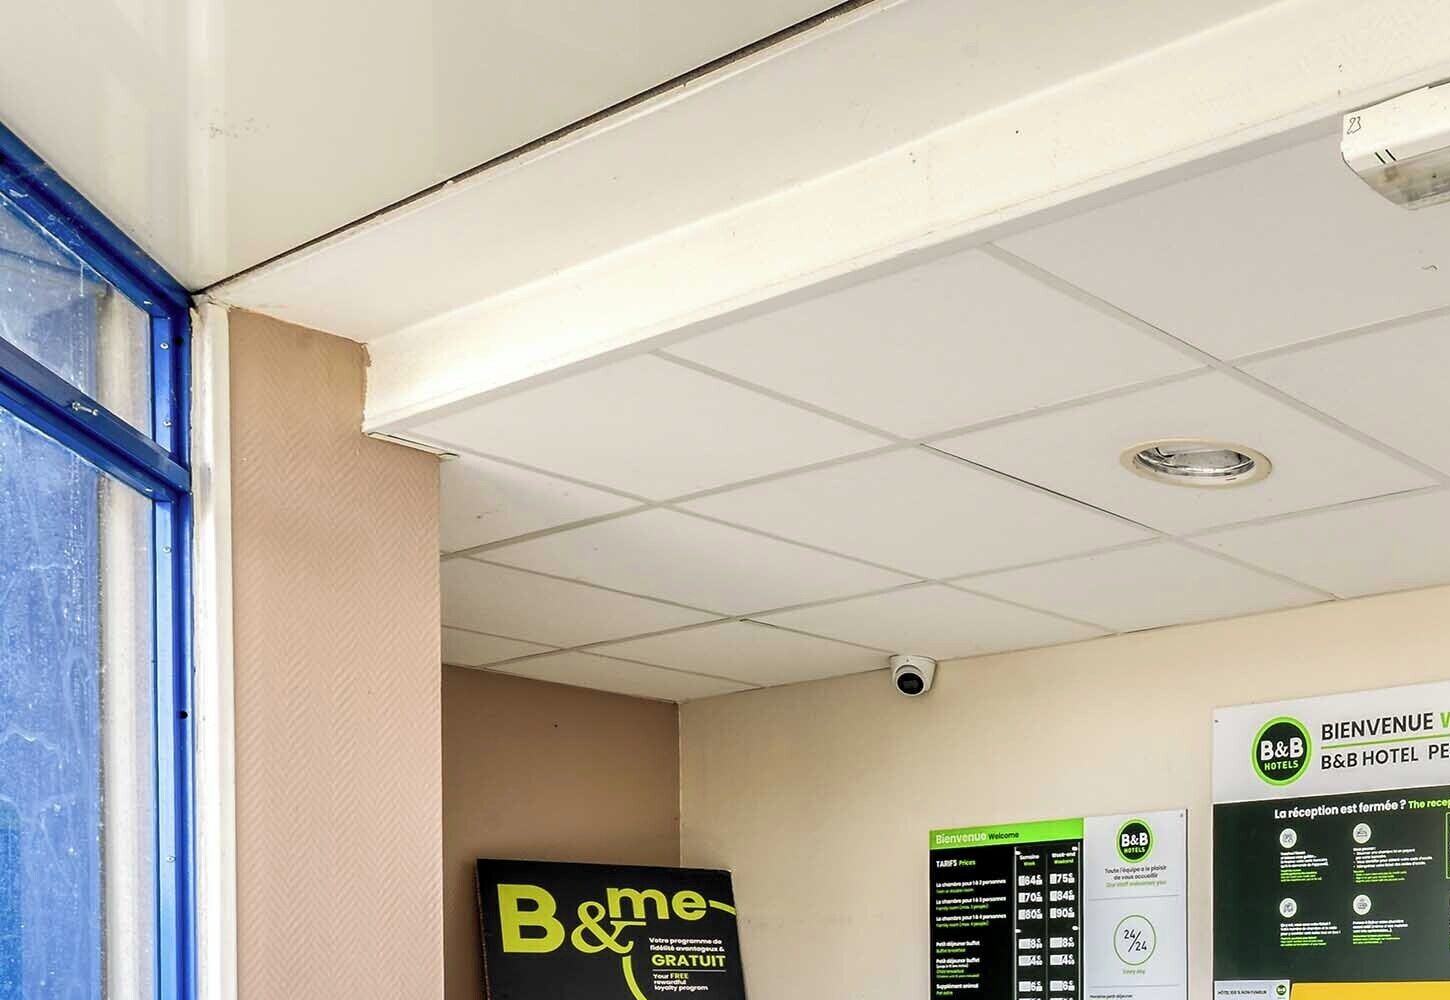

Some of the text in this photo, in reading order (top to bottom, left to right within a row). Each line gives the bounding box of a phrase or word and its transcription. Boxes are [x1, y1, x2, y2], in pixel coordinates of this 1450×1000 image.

[1321, 712, 1434, 741] BIENVENUE
[1260, 736, 1304, 760] B&B
[1320, 747, 1358, 770] B&B
[1362, 744, 1418, 767] HOTEL
[1264, 760, 1299, 771] HOTELS
[1274, 808, 1288, 820] La
[1288, 804, 1339, 819] réception
[1339, 803, 1357, 815] est
[1358, 800, 1399, 814] fermée
[1408, 798, 1426, 809] The
[935, 831, 1020, 845] Bienvenue Welcome
[1121, 832, 1149, 848] B&B
[935, 859, 958, 868] TARIFS
[1150, 865, 1167, 873] plaisir
[669, 937, 712, 945] programme
[651, 954, 726, 967] GRATUIT
[670, 972, 689, 980] FREE
